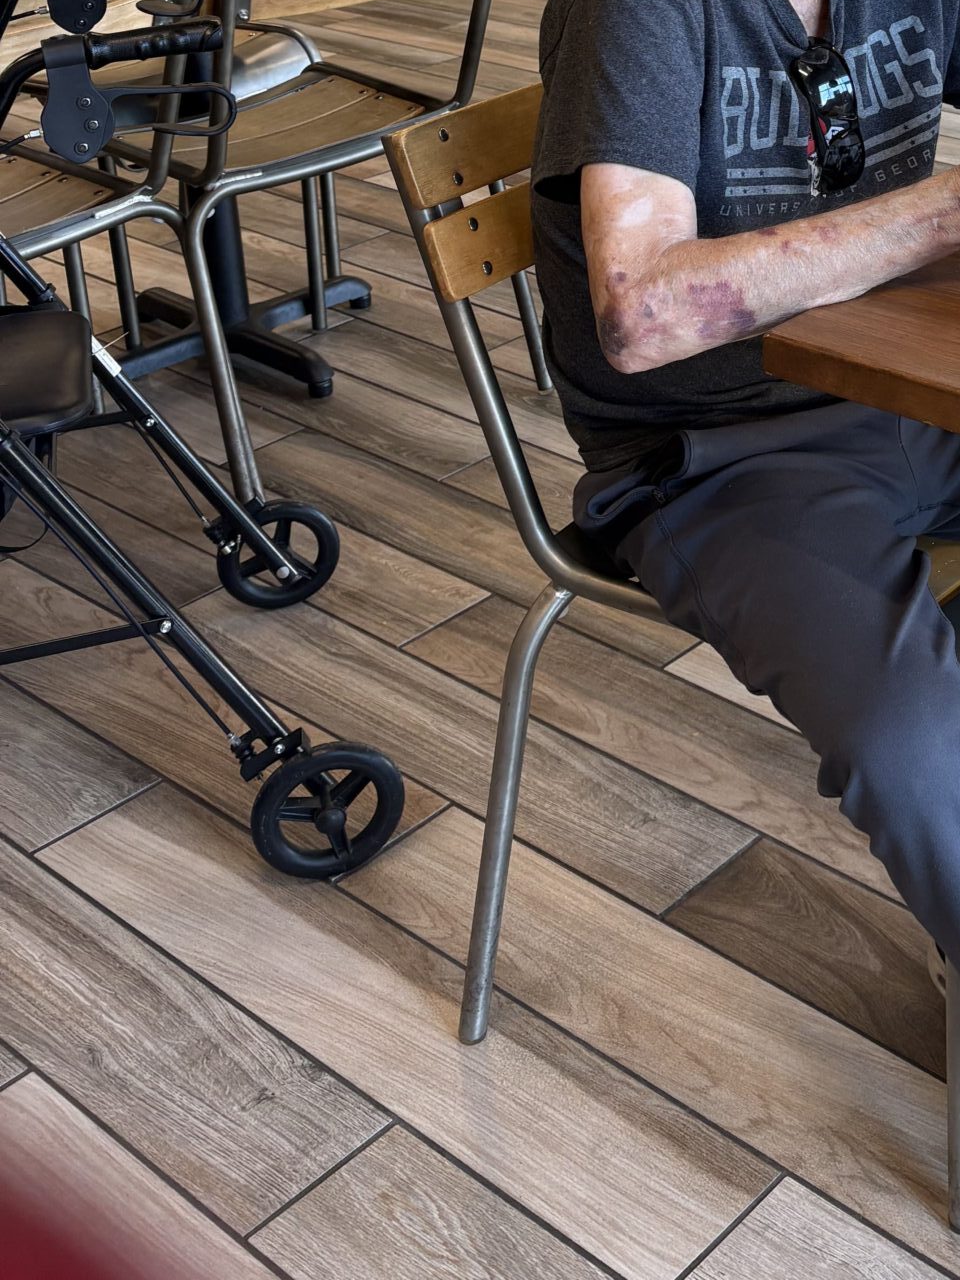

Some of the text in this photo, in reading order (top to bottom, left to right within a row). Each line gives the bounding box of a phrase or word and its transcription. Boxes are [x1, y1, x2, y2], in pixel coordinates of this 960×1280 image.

[720, 15, 943, 159] BULOGS
[874, 149, 933, 183] GEOR
[719, 200, 801, 217] UNIVERS
